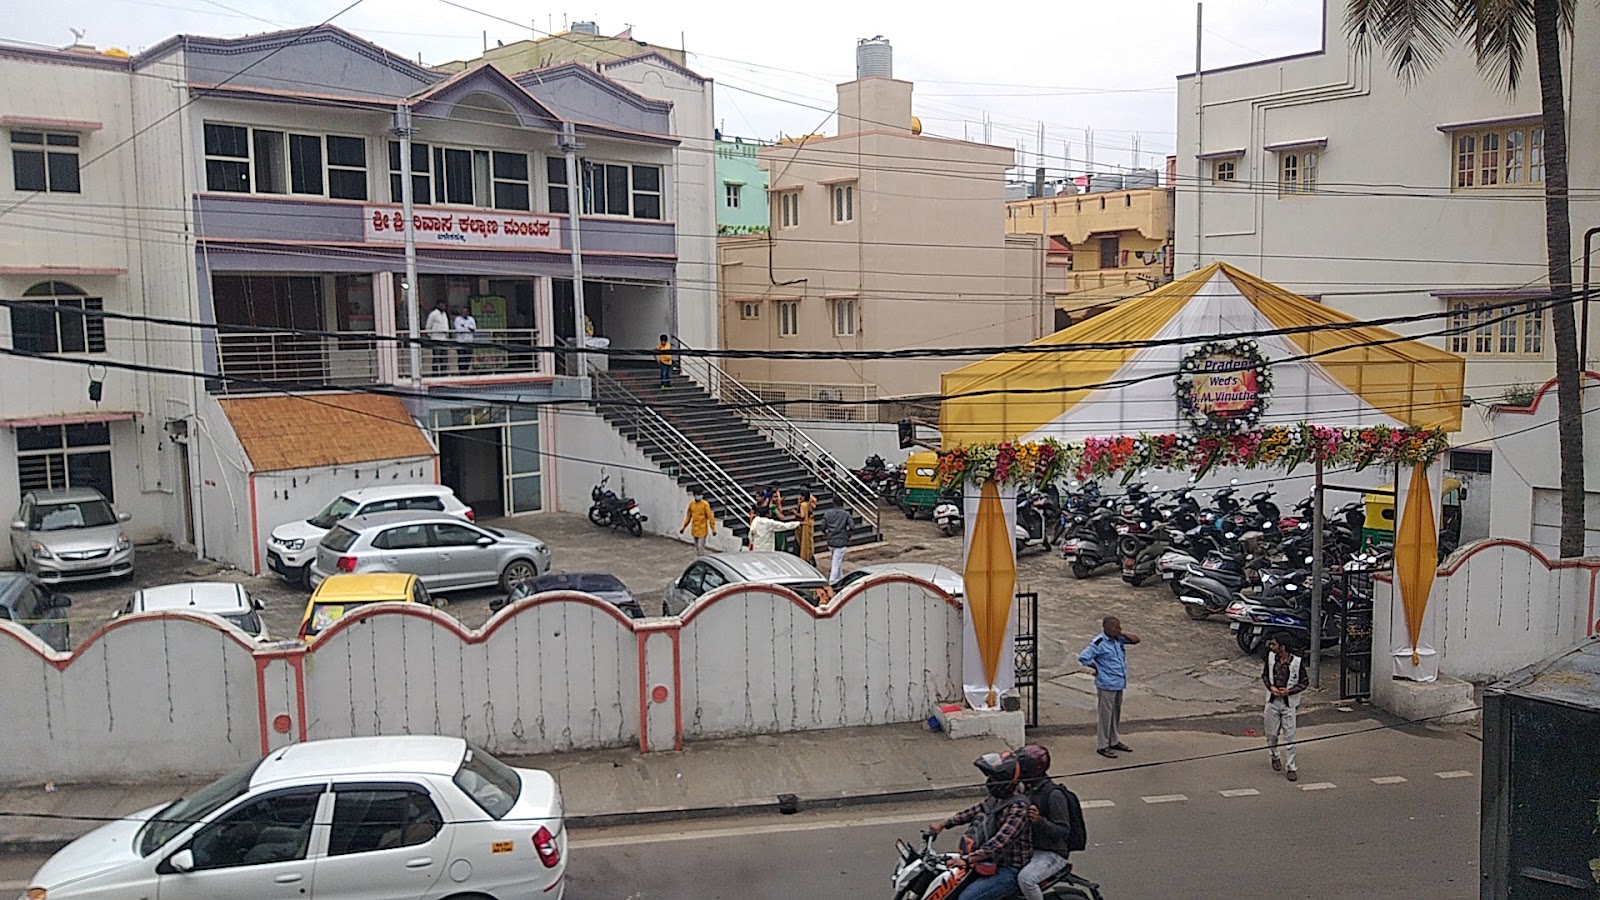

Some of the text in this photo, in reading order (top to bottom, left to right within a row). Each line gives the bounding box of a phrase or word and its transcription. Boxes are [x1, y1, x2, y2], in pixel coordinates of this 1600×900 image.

[373, 211, 389, 231] ಶ್ರೀ
[458, 216, 498, 238] ಕಲ್ಯಾಣ
[503, 219, 550, 236] ಮಂಟಪ
[1209, 377, 1237, 386] Wed's
